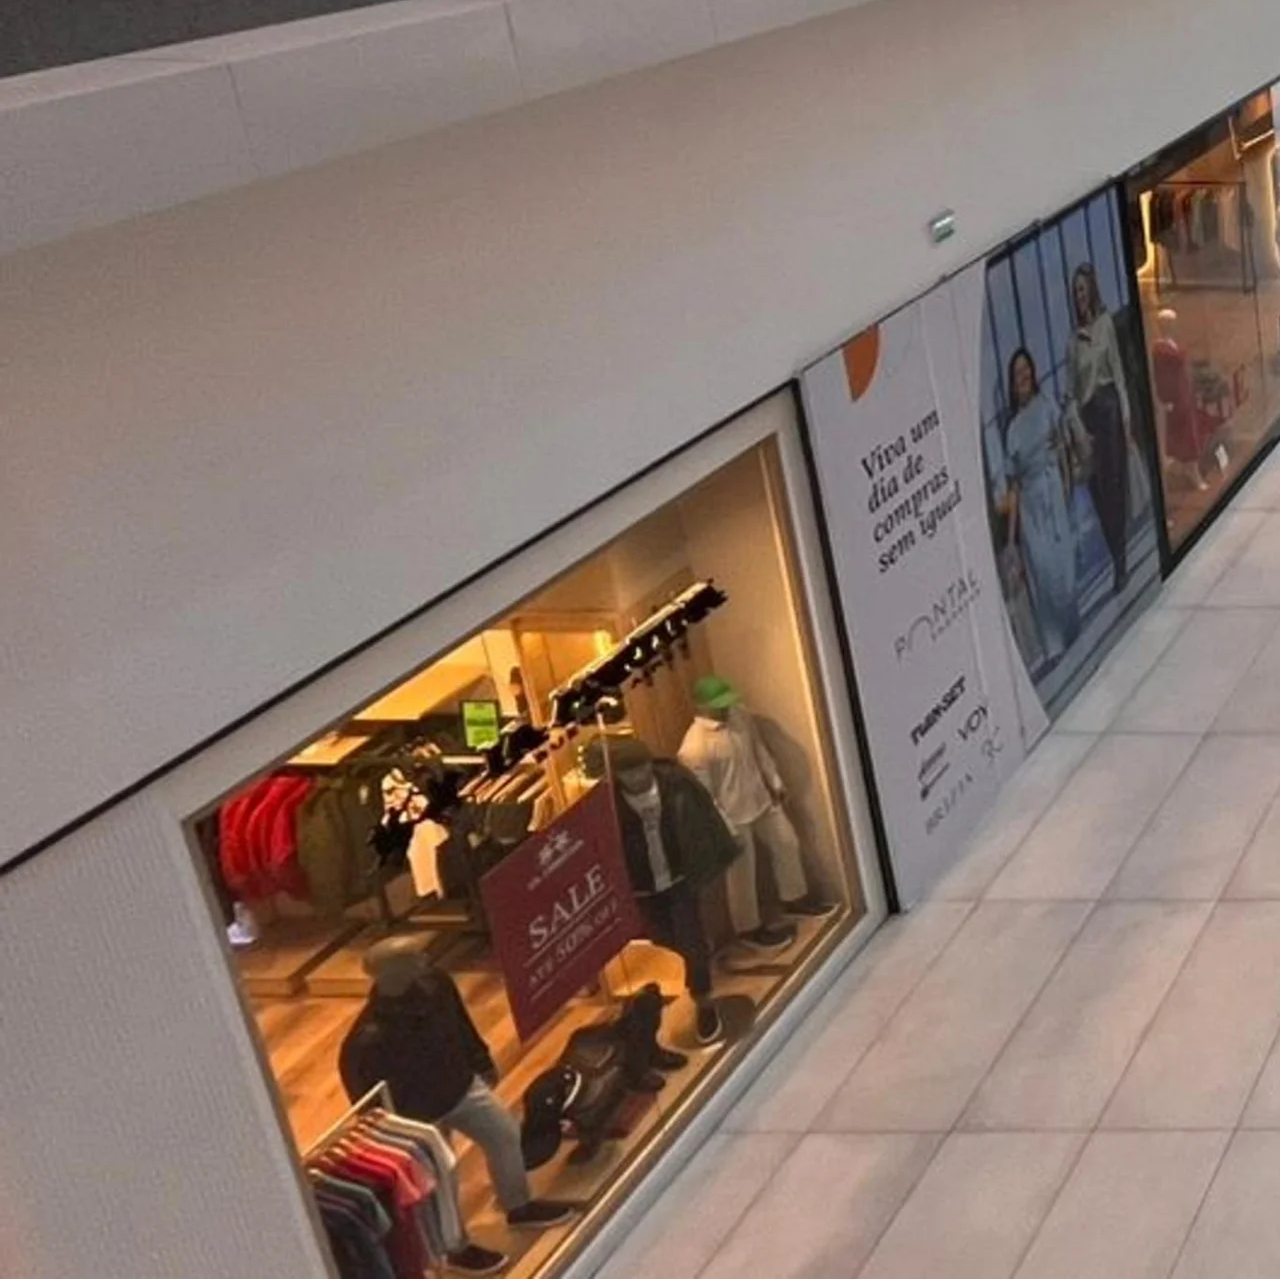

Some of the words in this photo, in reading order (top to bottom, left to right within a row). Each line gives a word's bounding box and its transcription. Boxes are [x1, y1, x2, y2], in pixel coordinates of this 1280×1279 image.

[861, 435, 906, 479] Viva
[910, 409, 940, 444] um
[868, 475, 900, 514] dia
[902, 454, 924, 485] de
[873, 465, 949, 543] compras
[878, 530, 916, 573] sem
[919, 480, 962, 539] igual
[528, 863, 606, 950] SALE
